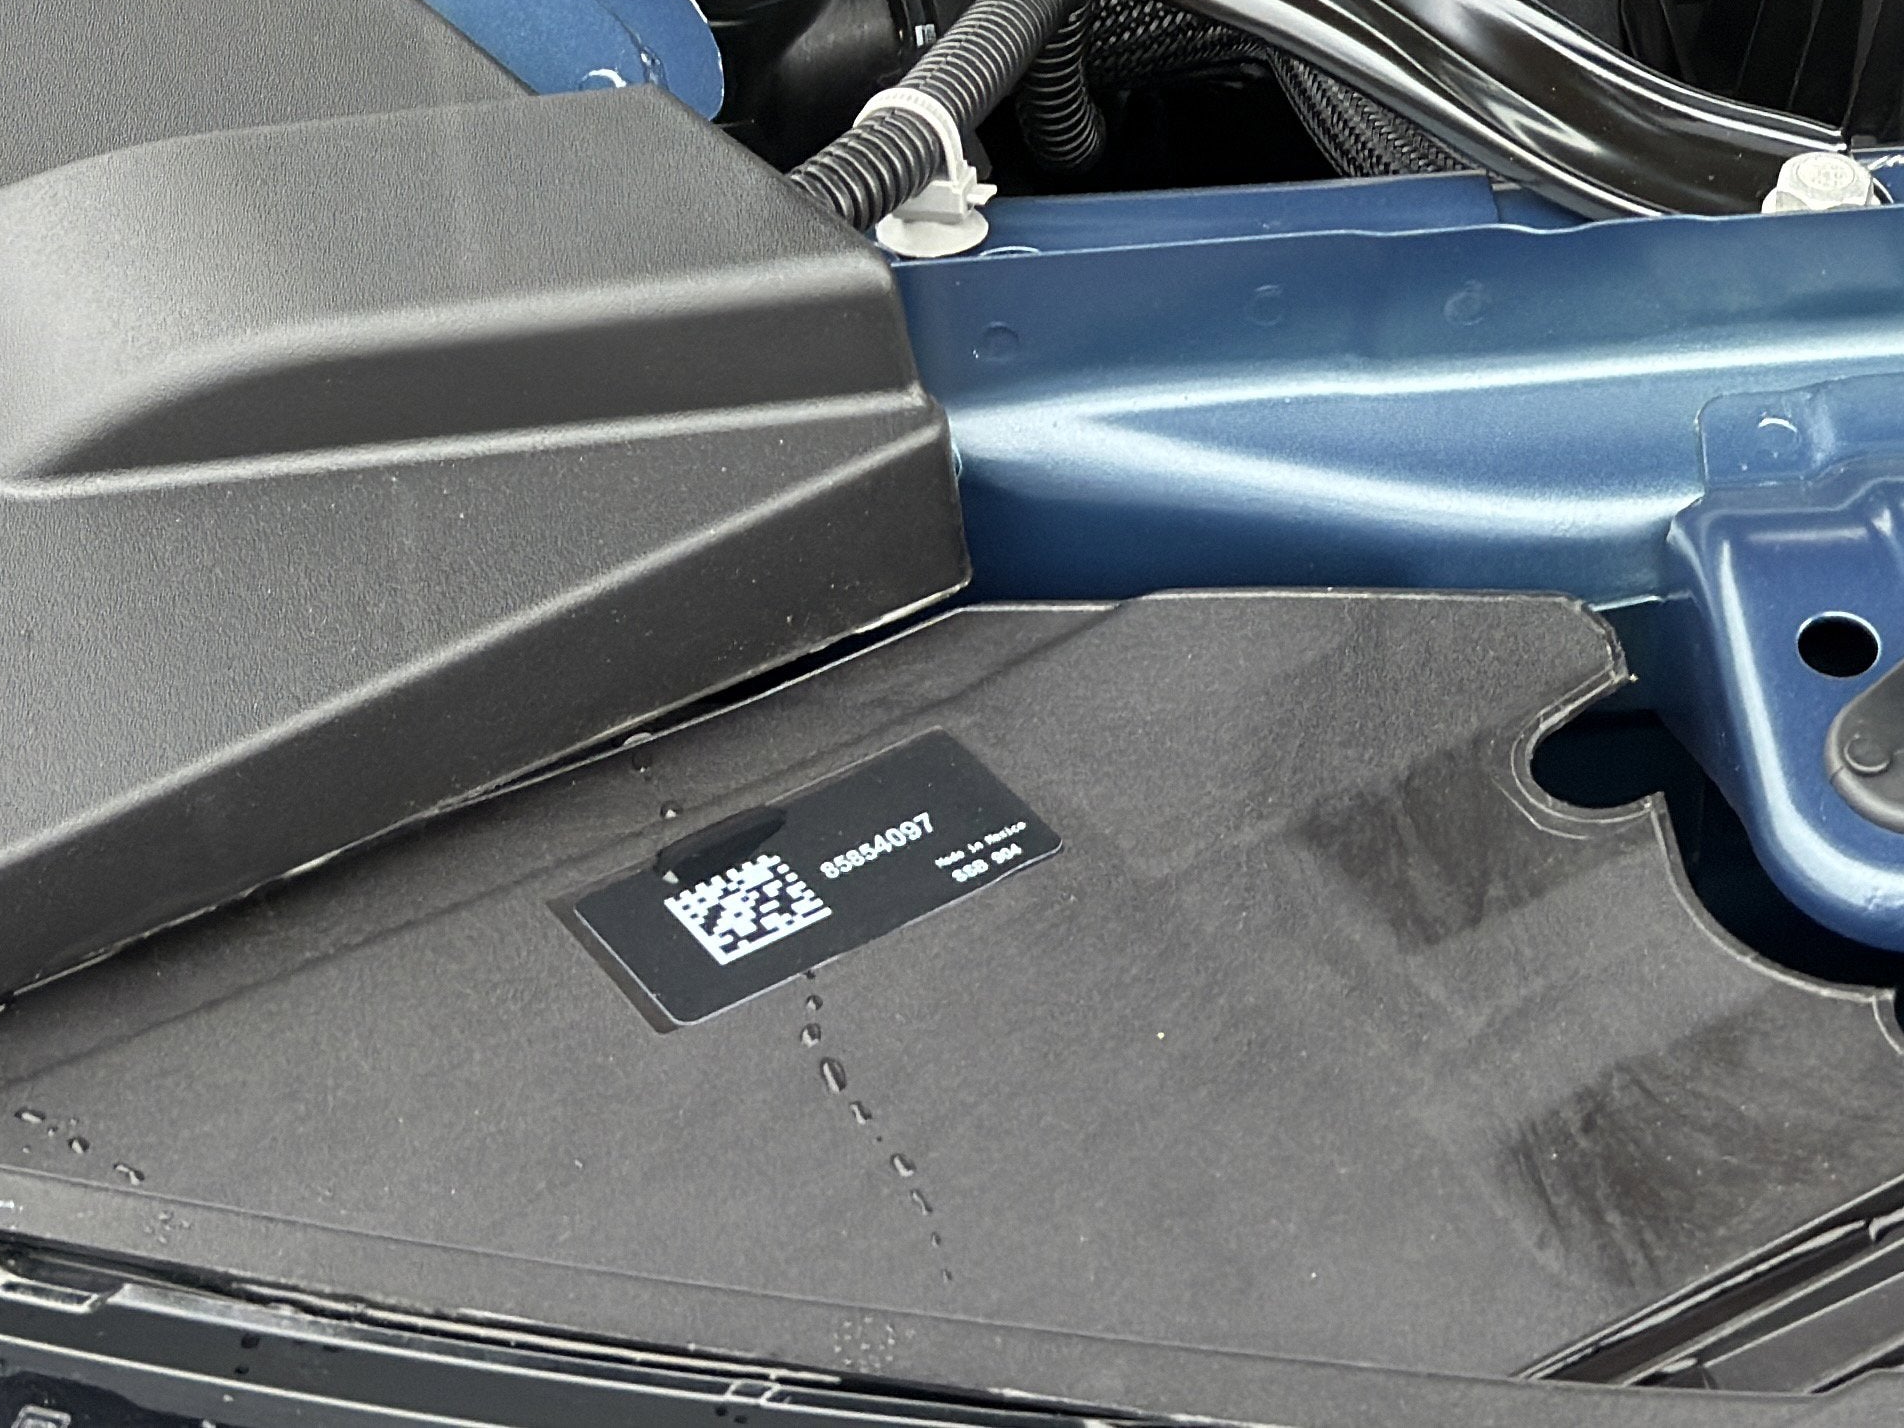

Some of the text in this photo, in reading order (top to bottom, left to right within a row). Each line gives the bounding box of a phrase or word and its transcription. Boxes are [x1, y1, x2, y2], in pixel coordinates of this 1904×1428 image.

[820, 812, 934, 878] 85854097
[967, 841, 984, 853] in
[984, 821, 1027, 845] Mexico
